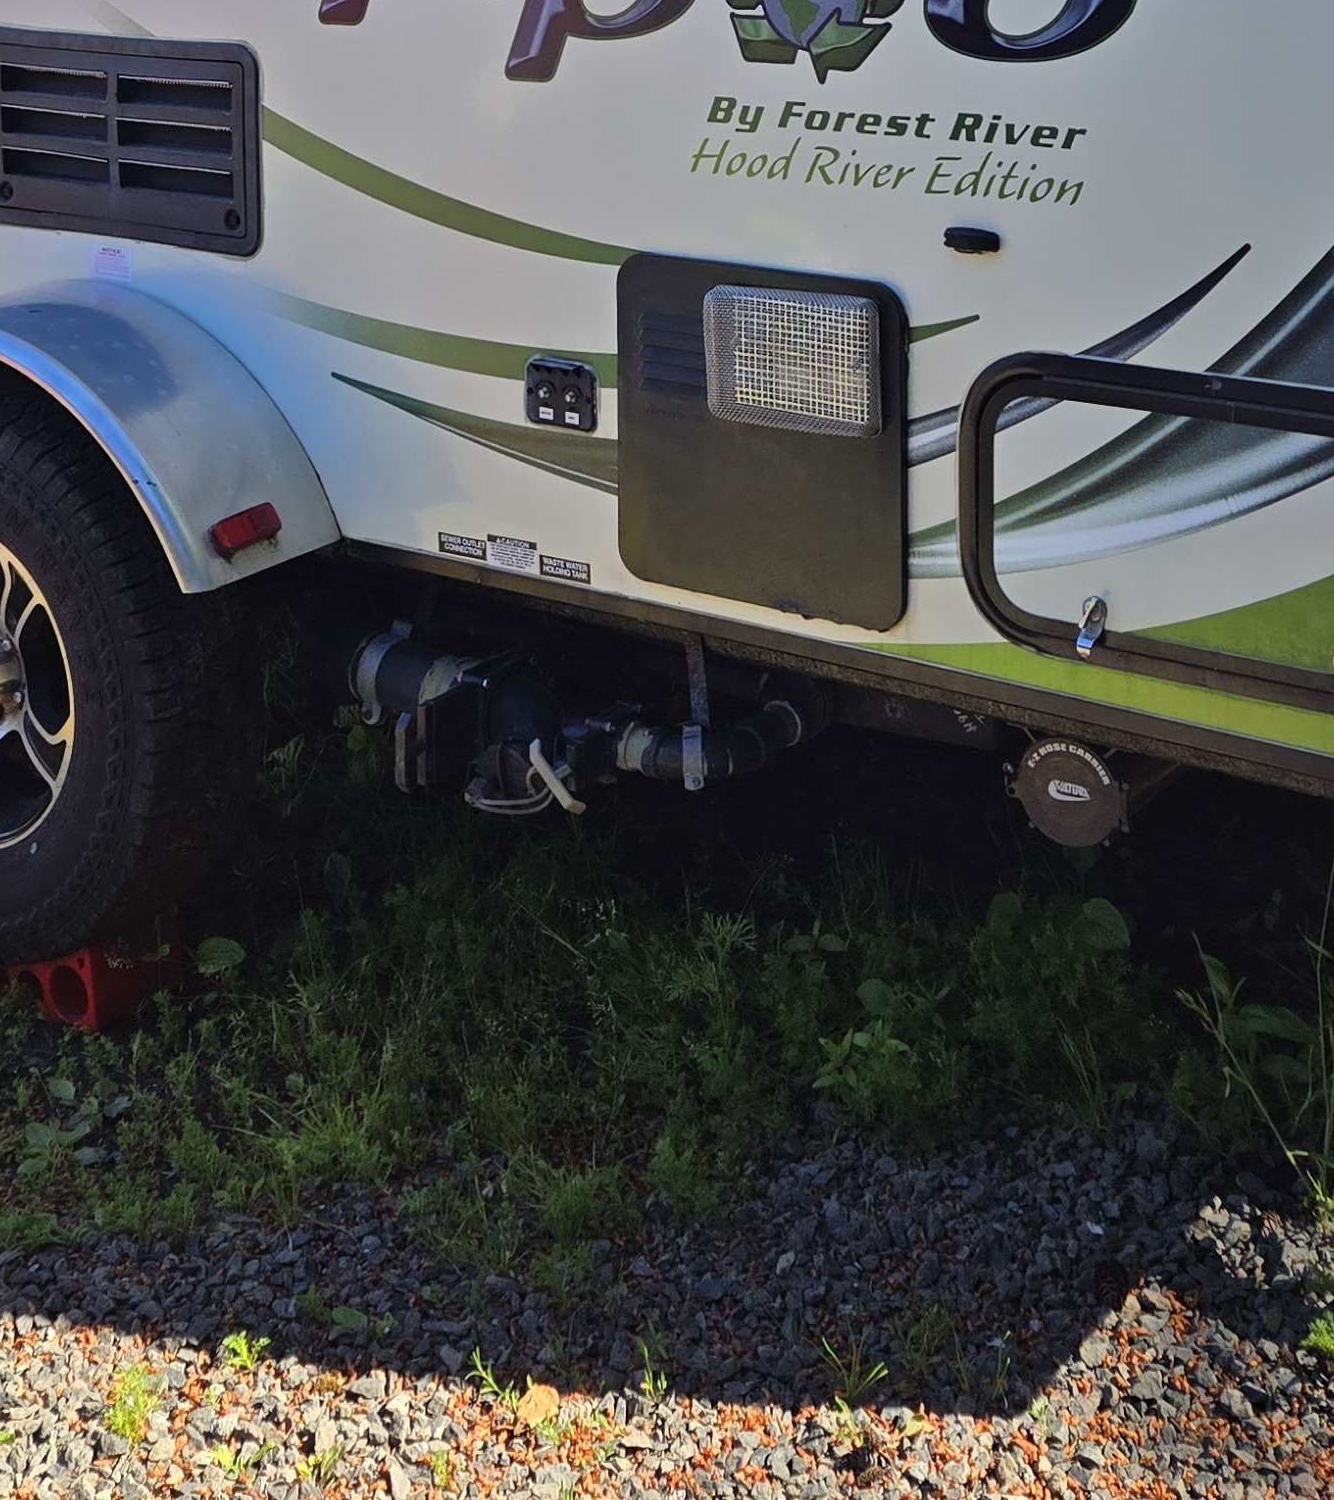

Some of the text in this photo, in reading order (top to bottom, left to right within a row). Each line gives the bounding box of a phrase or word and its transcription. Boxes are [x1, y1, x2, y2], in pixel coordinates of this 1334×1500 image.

[706, 94, 1087, 150] By Forest River
[690, 136, 1084, 206] Hood River Edition
[440, 533, 485, 549] SEWER OUTLET
[444, 542, 483, 556] CONNECTION
[502, 537, 530, 549] CAUTION
[542, 556, 565, 568] WASTE
[565, 561, 588, 572] WATER
[543, 565, 589, 580] HOLDING TANK
[1038, 742, 1067, 756] HOSE
[1069, 744, 1111, 786] CARRIER
